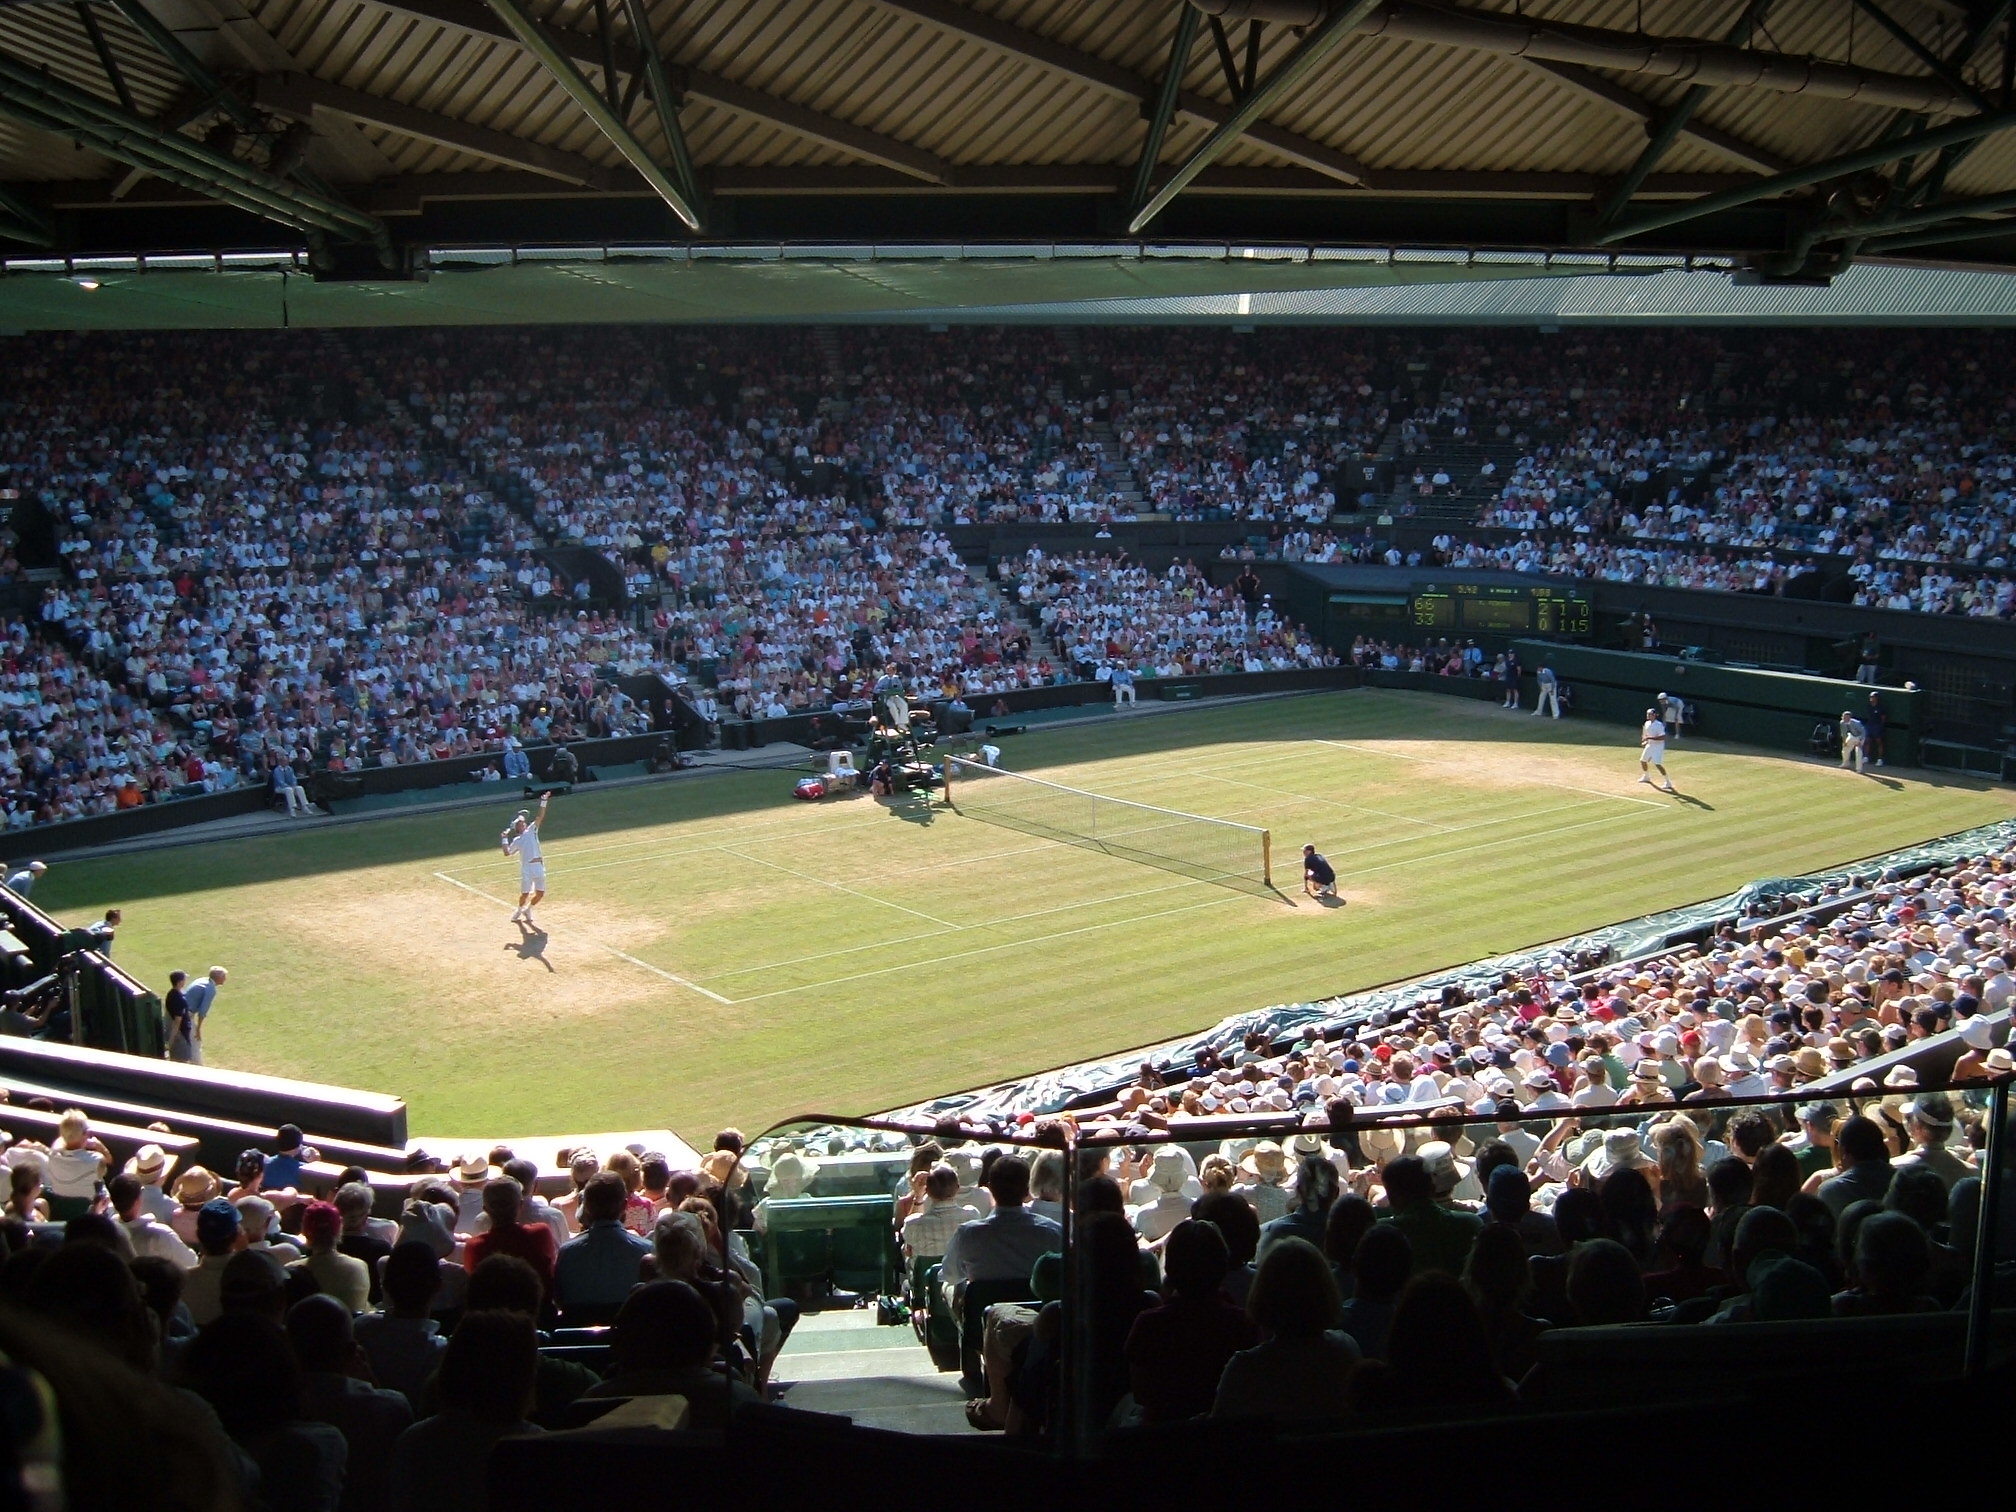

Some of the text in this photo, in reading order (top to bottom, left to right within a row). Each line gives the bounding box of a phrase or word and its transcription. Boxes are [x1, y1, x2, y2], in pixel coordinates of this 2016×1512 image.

[1538, 602, 1589, 616] 2 1 0
[1538, 618, 1588, 632] 0 1 15
